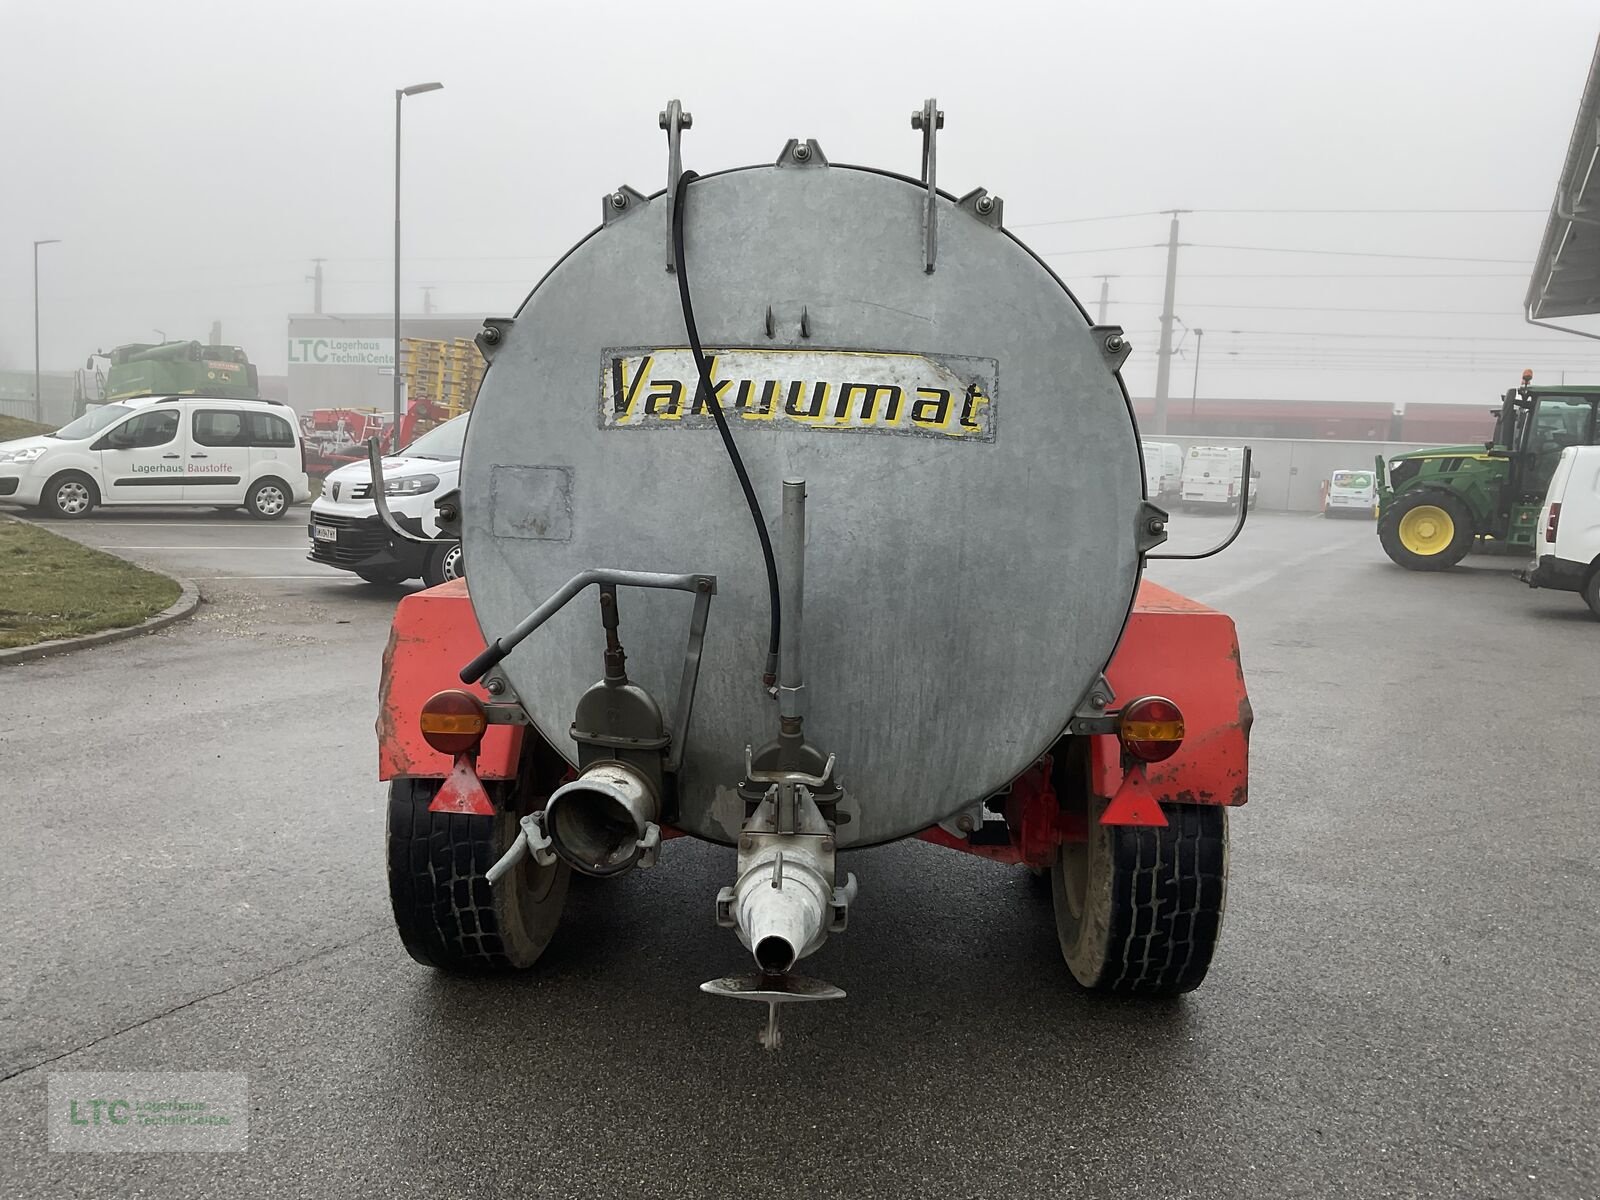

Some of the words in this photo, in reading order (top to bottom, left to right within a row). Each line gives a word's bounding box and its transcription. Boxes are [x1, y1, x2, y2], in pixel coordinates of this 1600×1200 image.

[288, 339, 329, 362] LTC
[330, 340, 380, 351] Lagerhaus
[330, 353, 395, 364] TechnikCente
[611, 355, 989, 428] Vakuumat
[131, 463, 184, 474] Lagerhaus
[187, 463, 233, 473] Baustoffe
